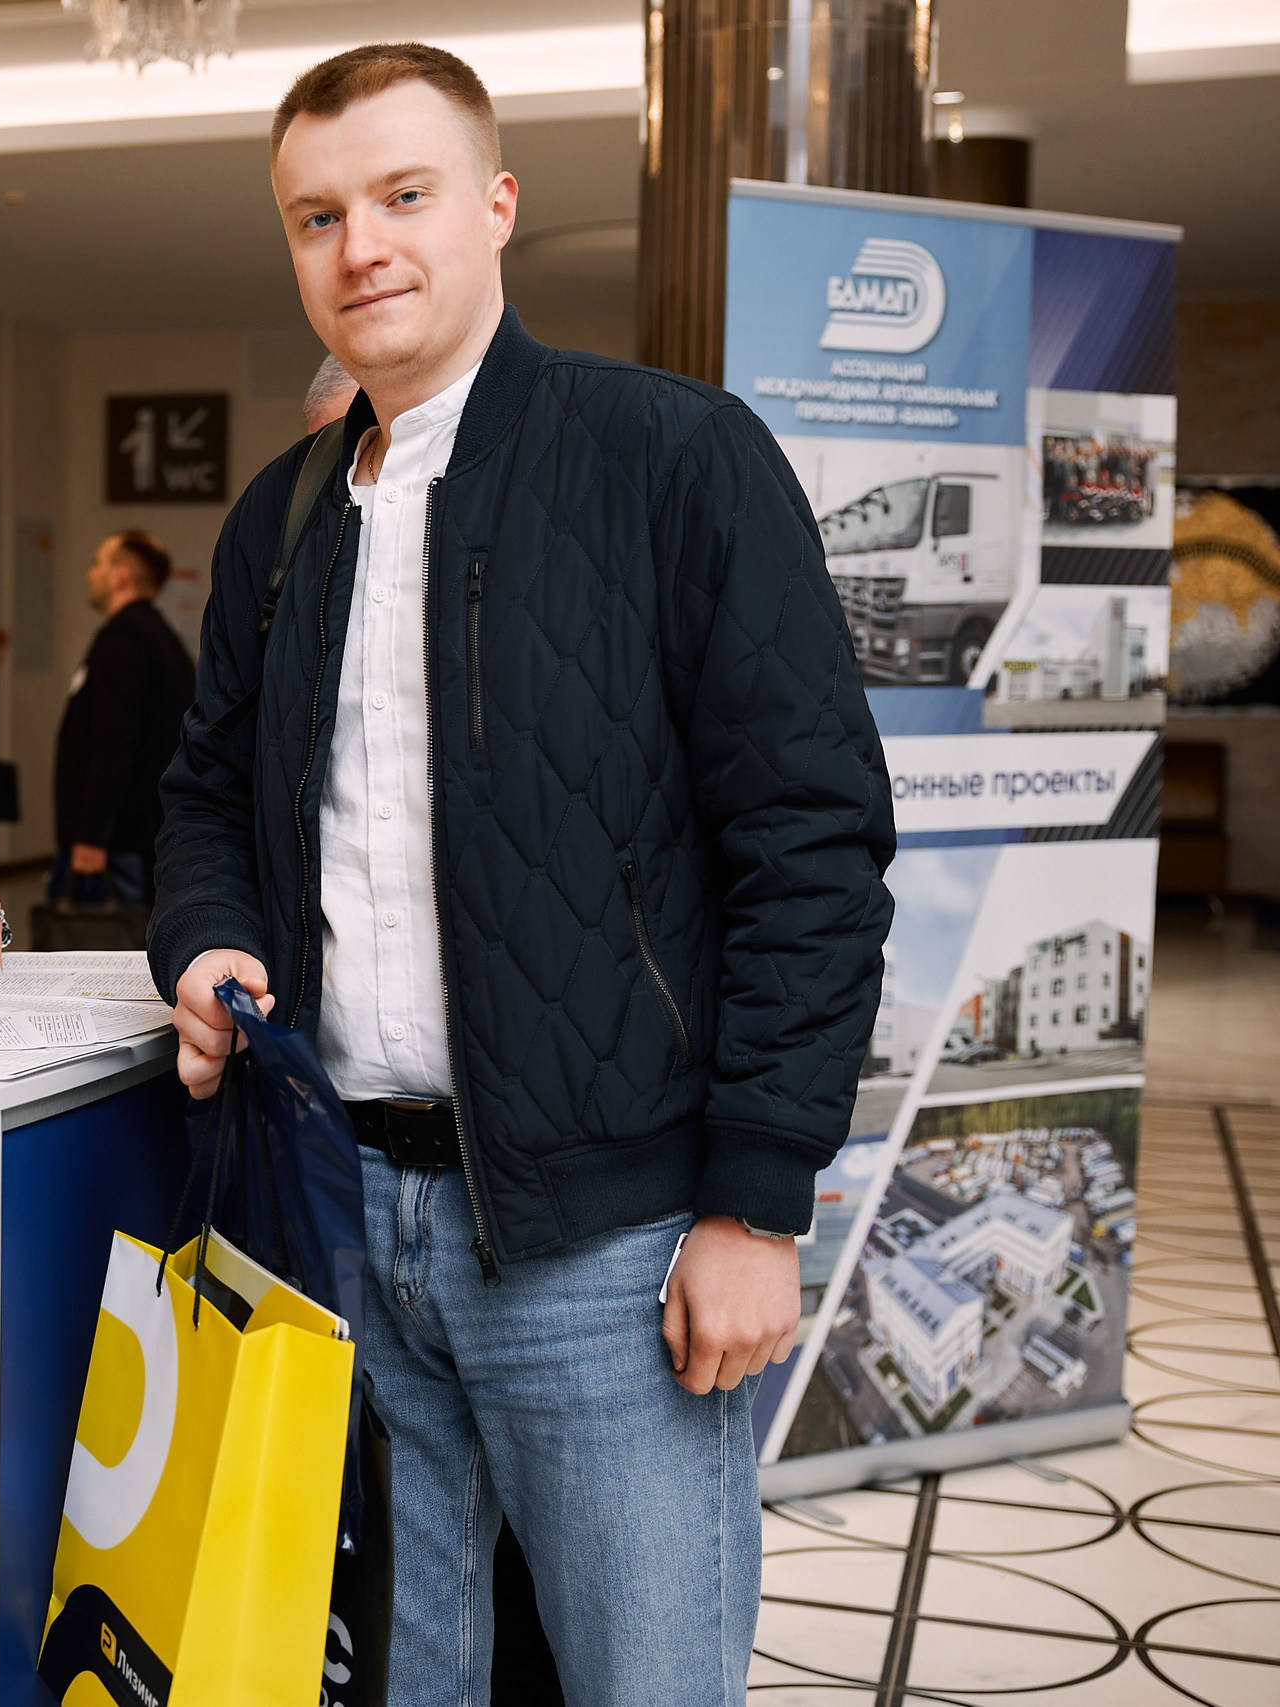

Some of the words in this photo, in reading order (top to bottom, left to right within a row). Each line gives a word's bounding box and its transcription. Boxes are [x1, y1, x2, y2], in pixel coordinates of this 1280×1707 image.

[828, 276, 916, 315] БАМАП
[161, 462, 216, 492] WC
[992, 768, 1116, 803] проекты
